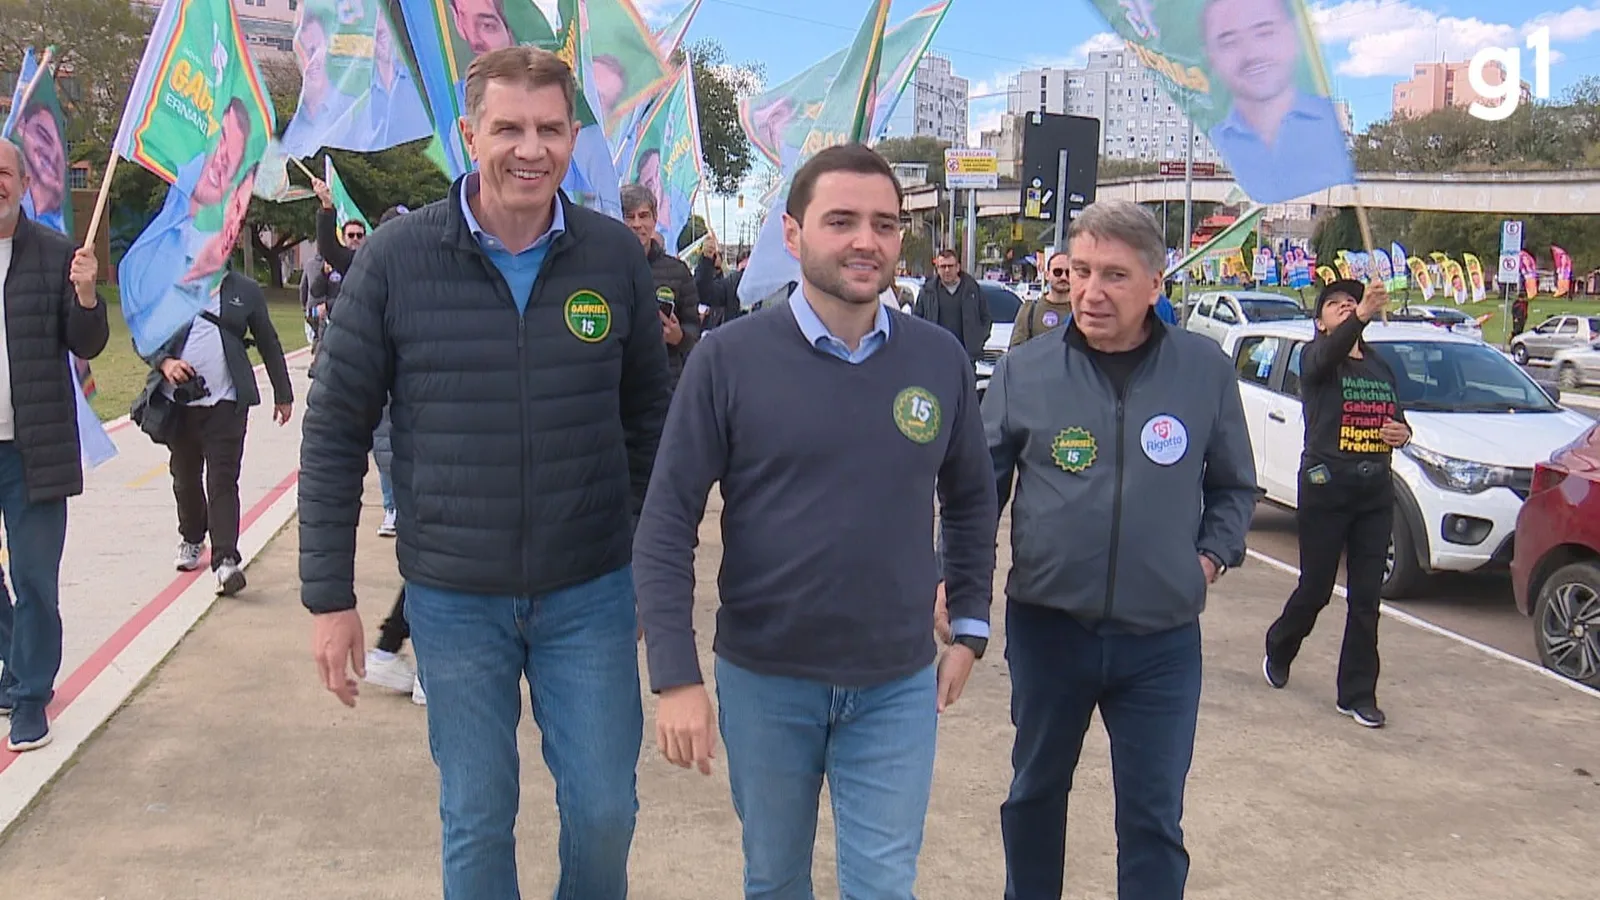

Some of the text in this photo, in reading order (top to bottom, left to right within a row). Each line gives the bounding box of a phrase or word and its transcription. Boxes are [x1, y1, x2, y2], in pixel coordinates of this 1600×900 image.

[571, 304, 607, 314] GABRIEL
[582, 318, 596, 336] 15
[911, 396, 932, 422] 15
[1343, 401, 1387, 413] Gabriel
[1342, 414, 1381, 427] Ernani
[1147, 435, 1183, 452] Rigotto
[1067, 449, 1080, 464] 15
